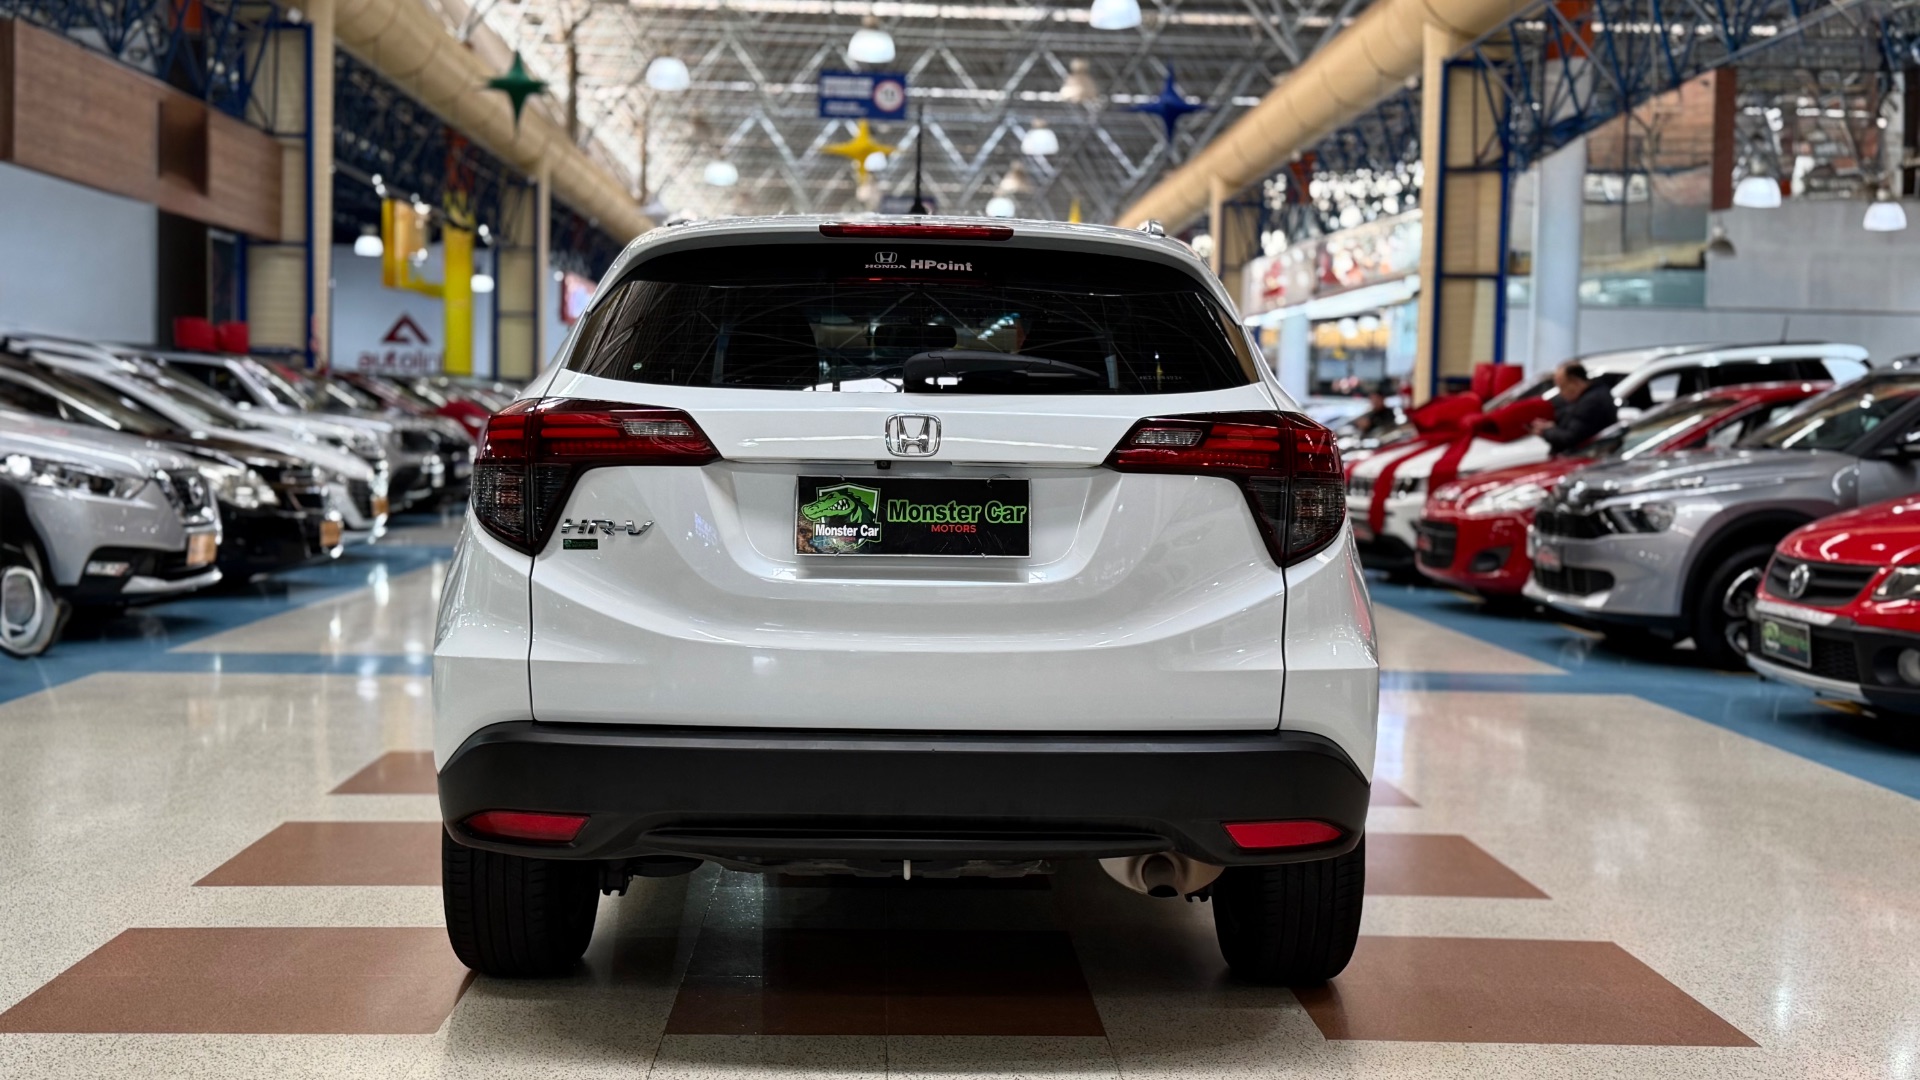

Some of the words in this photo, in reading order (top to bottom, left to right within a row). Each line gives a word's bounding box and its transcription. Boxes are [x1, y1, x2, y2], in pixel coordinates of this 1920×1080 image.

[910, 259, 972, 272] HPoint
[358, 351, 447, 368] autolin
[888, 499, 981, 523] Monster
[985, 501, 1027, 524] Car
[561, 518, 654, 536] HR-V
[815, 524, 858, 537] Monster
[860, 525, 880, 537] Car
[931, 524, 977, 533] MOTORS
